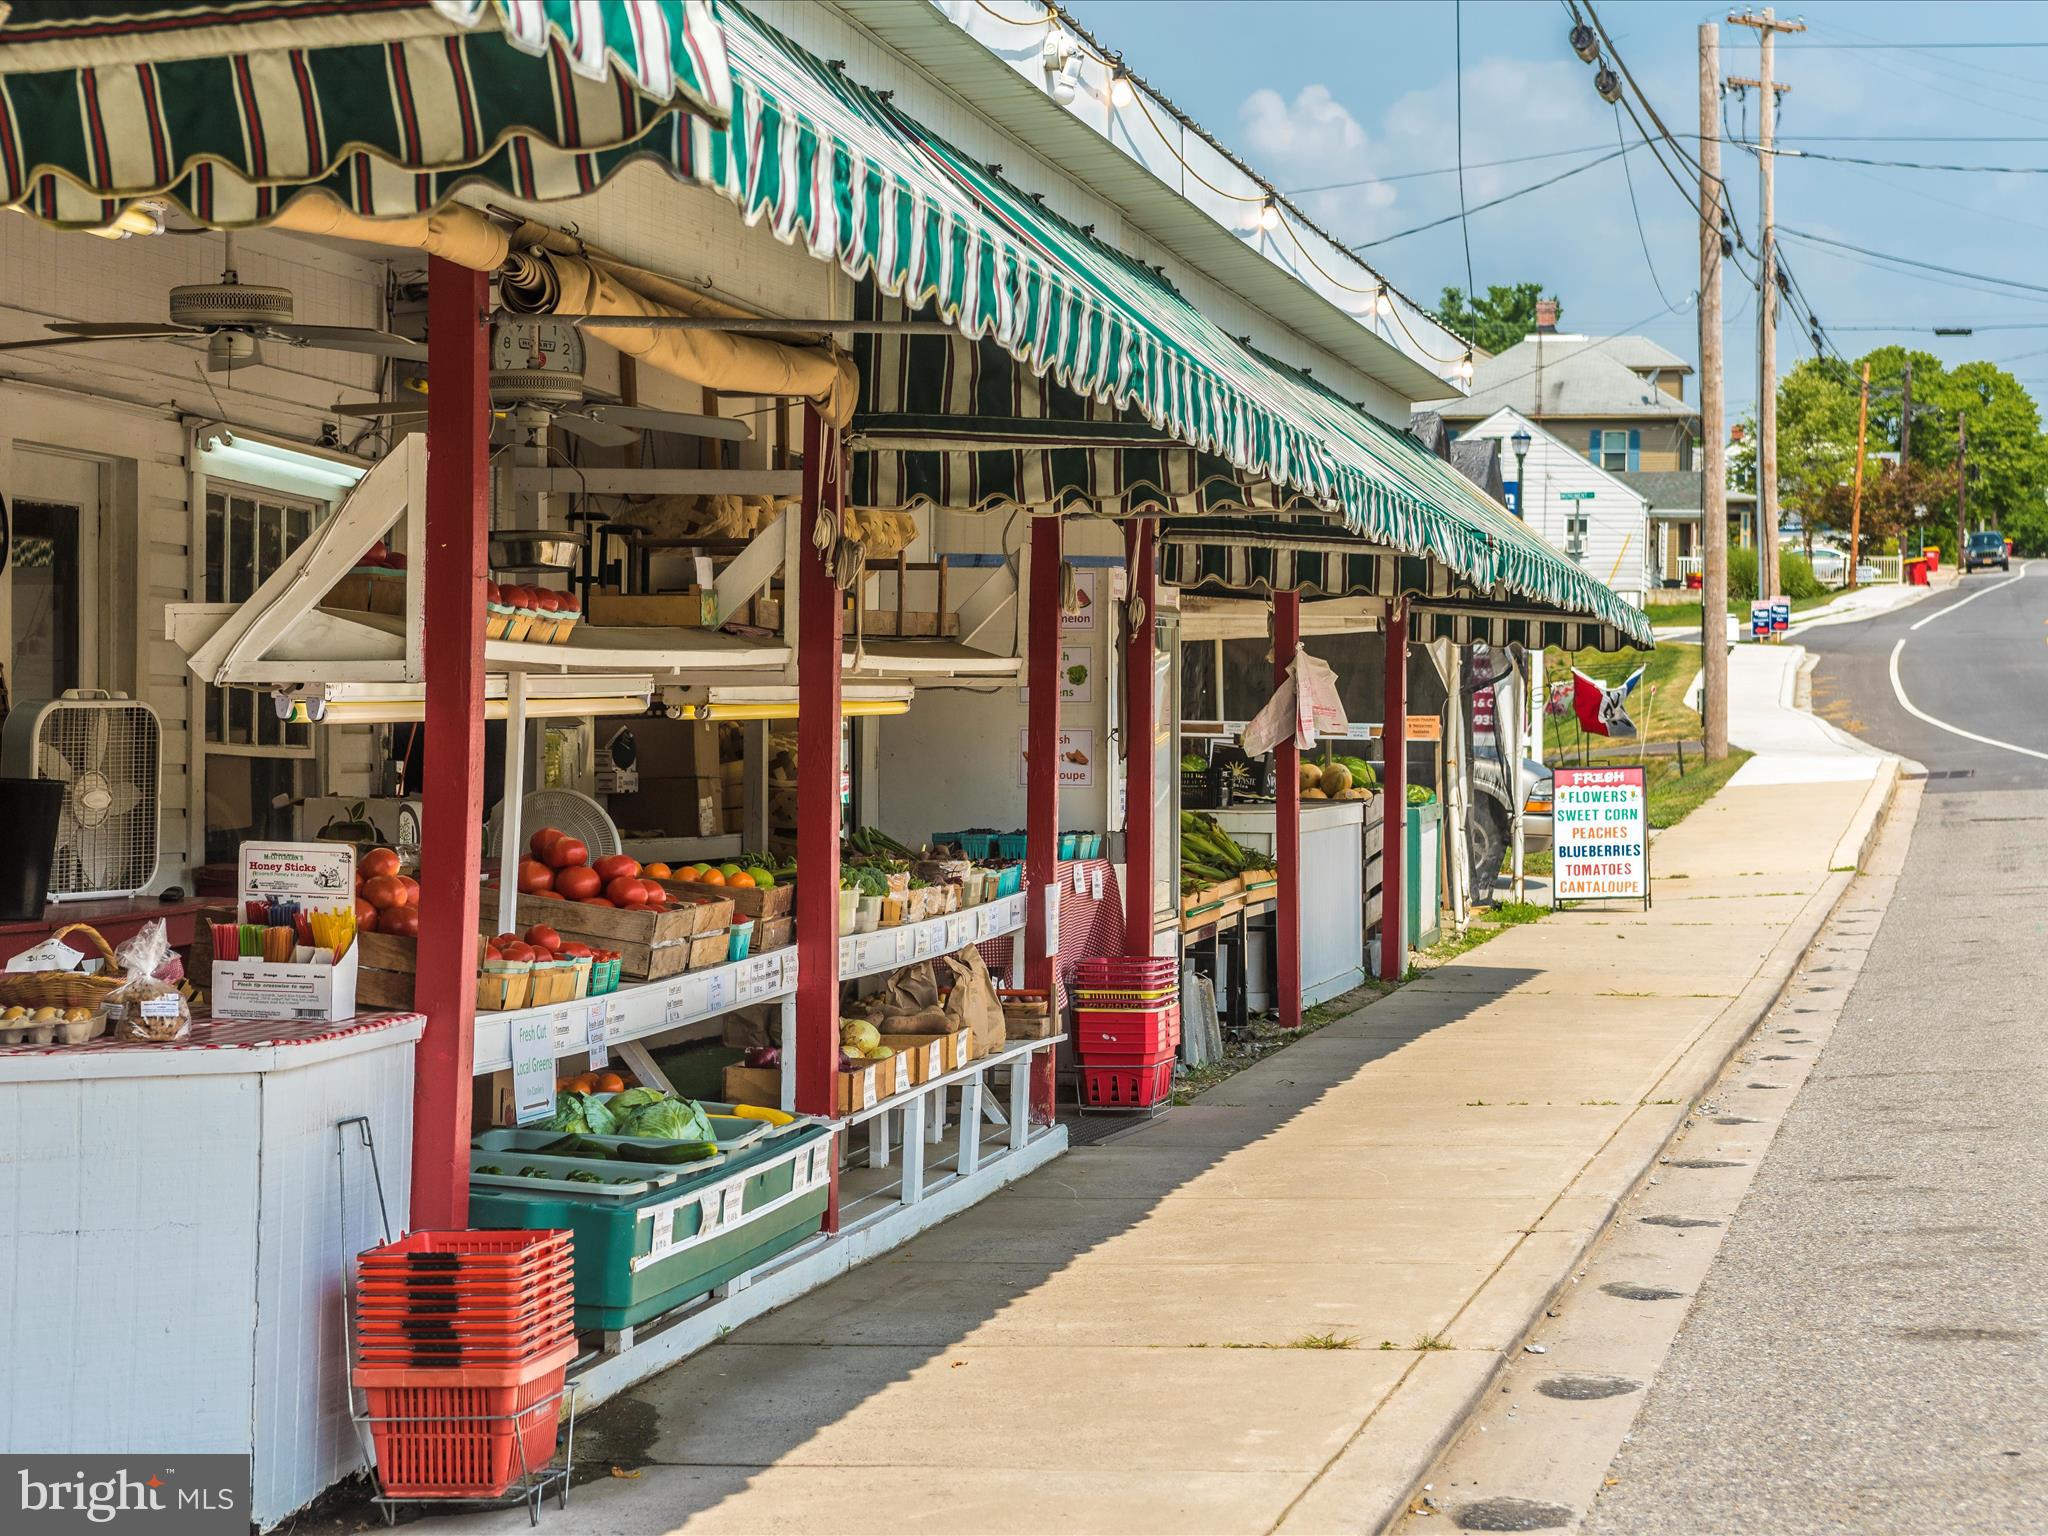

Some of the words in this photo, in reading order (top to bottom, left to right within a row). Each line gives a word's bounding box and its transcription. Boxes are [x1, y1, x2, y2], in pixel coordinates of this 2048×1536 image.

[562, 343, 570, 356] 2
[1572, 772, 1624, 784] FRESH
[1568, 790, 1627, 803] FLOWERS
[1557, 809, 1600, 822] SWEET
[1605, 808, 1638, 821] CORN
[1572, 826, 1628, 839] PEACHES
[1559, 844, 1641, 858] BLUEBERRIES
[249, 861, 282, 872] Honey
[284, 862, 317, 872] Sticks
[1565, 863, 1632, 876] TOMATOES
[1560, 880, 1639, 894] CANTALOUPE
[520, 1025, 536, 1042] Fresh
[537, 1024, 547, 1040] Cut
[516, 1056, 531, 1076] Local
[532, 1057, 553, 1073] Greens
